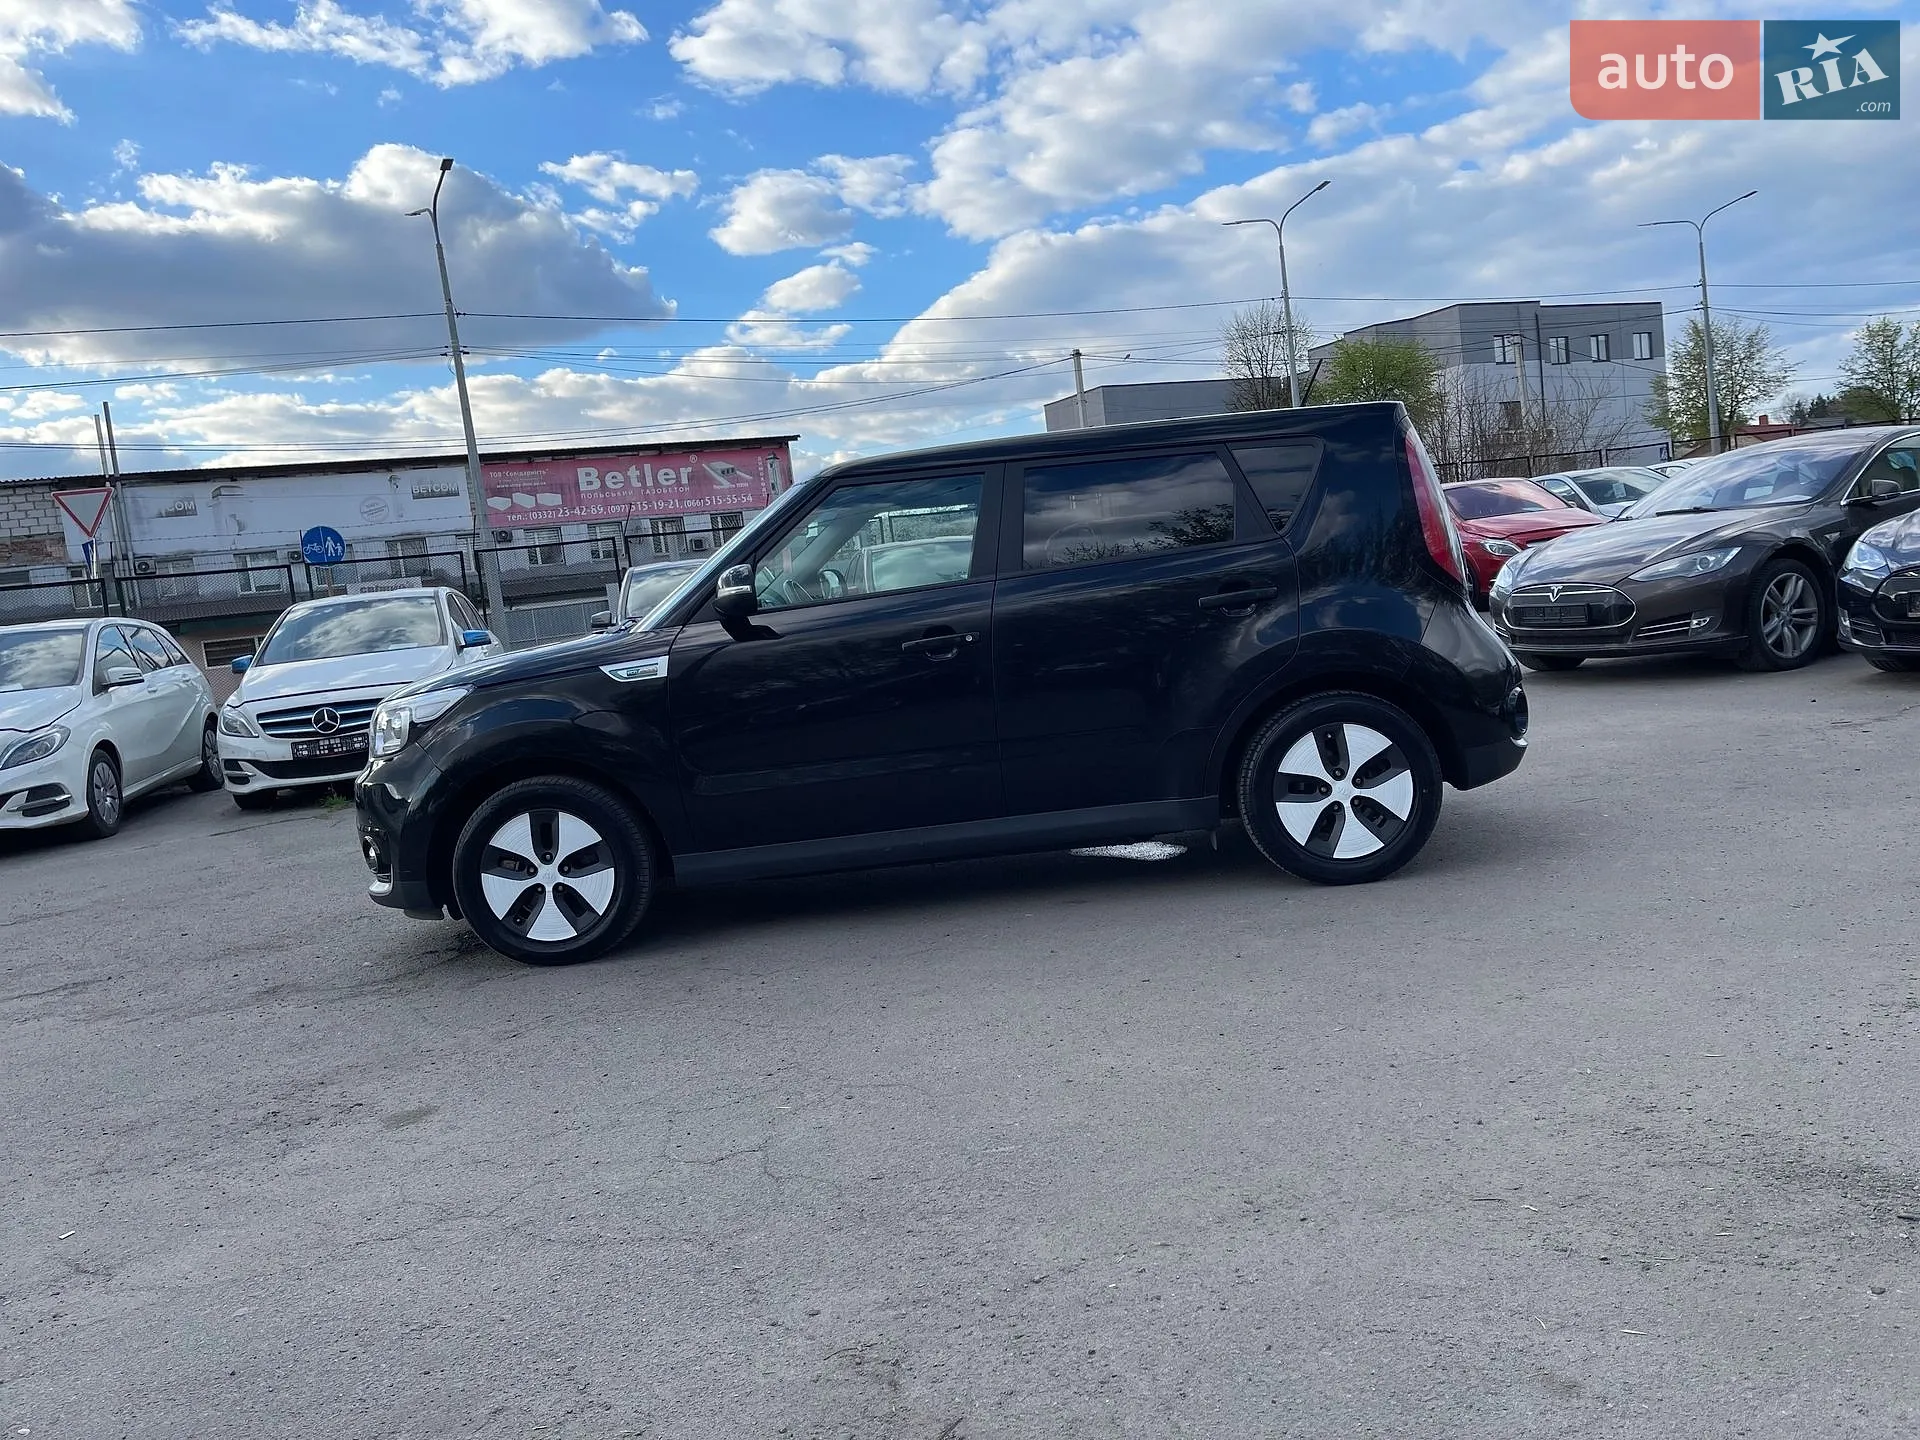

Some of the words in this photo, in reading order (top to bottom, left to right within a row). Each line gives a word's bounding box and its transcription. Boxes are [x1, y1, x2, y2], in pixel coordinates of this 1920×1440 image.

[577, 463, 693, 491] Betler
[529, 510, 556, 521] (0332)
[705, 493, 753, 506] 515-55-54
